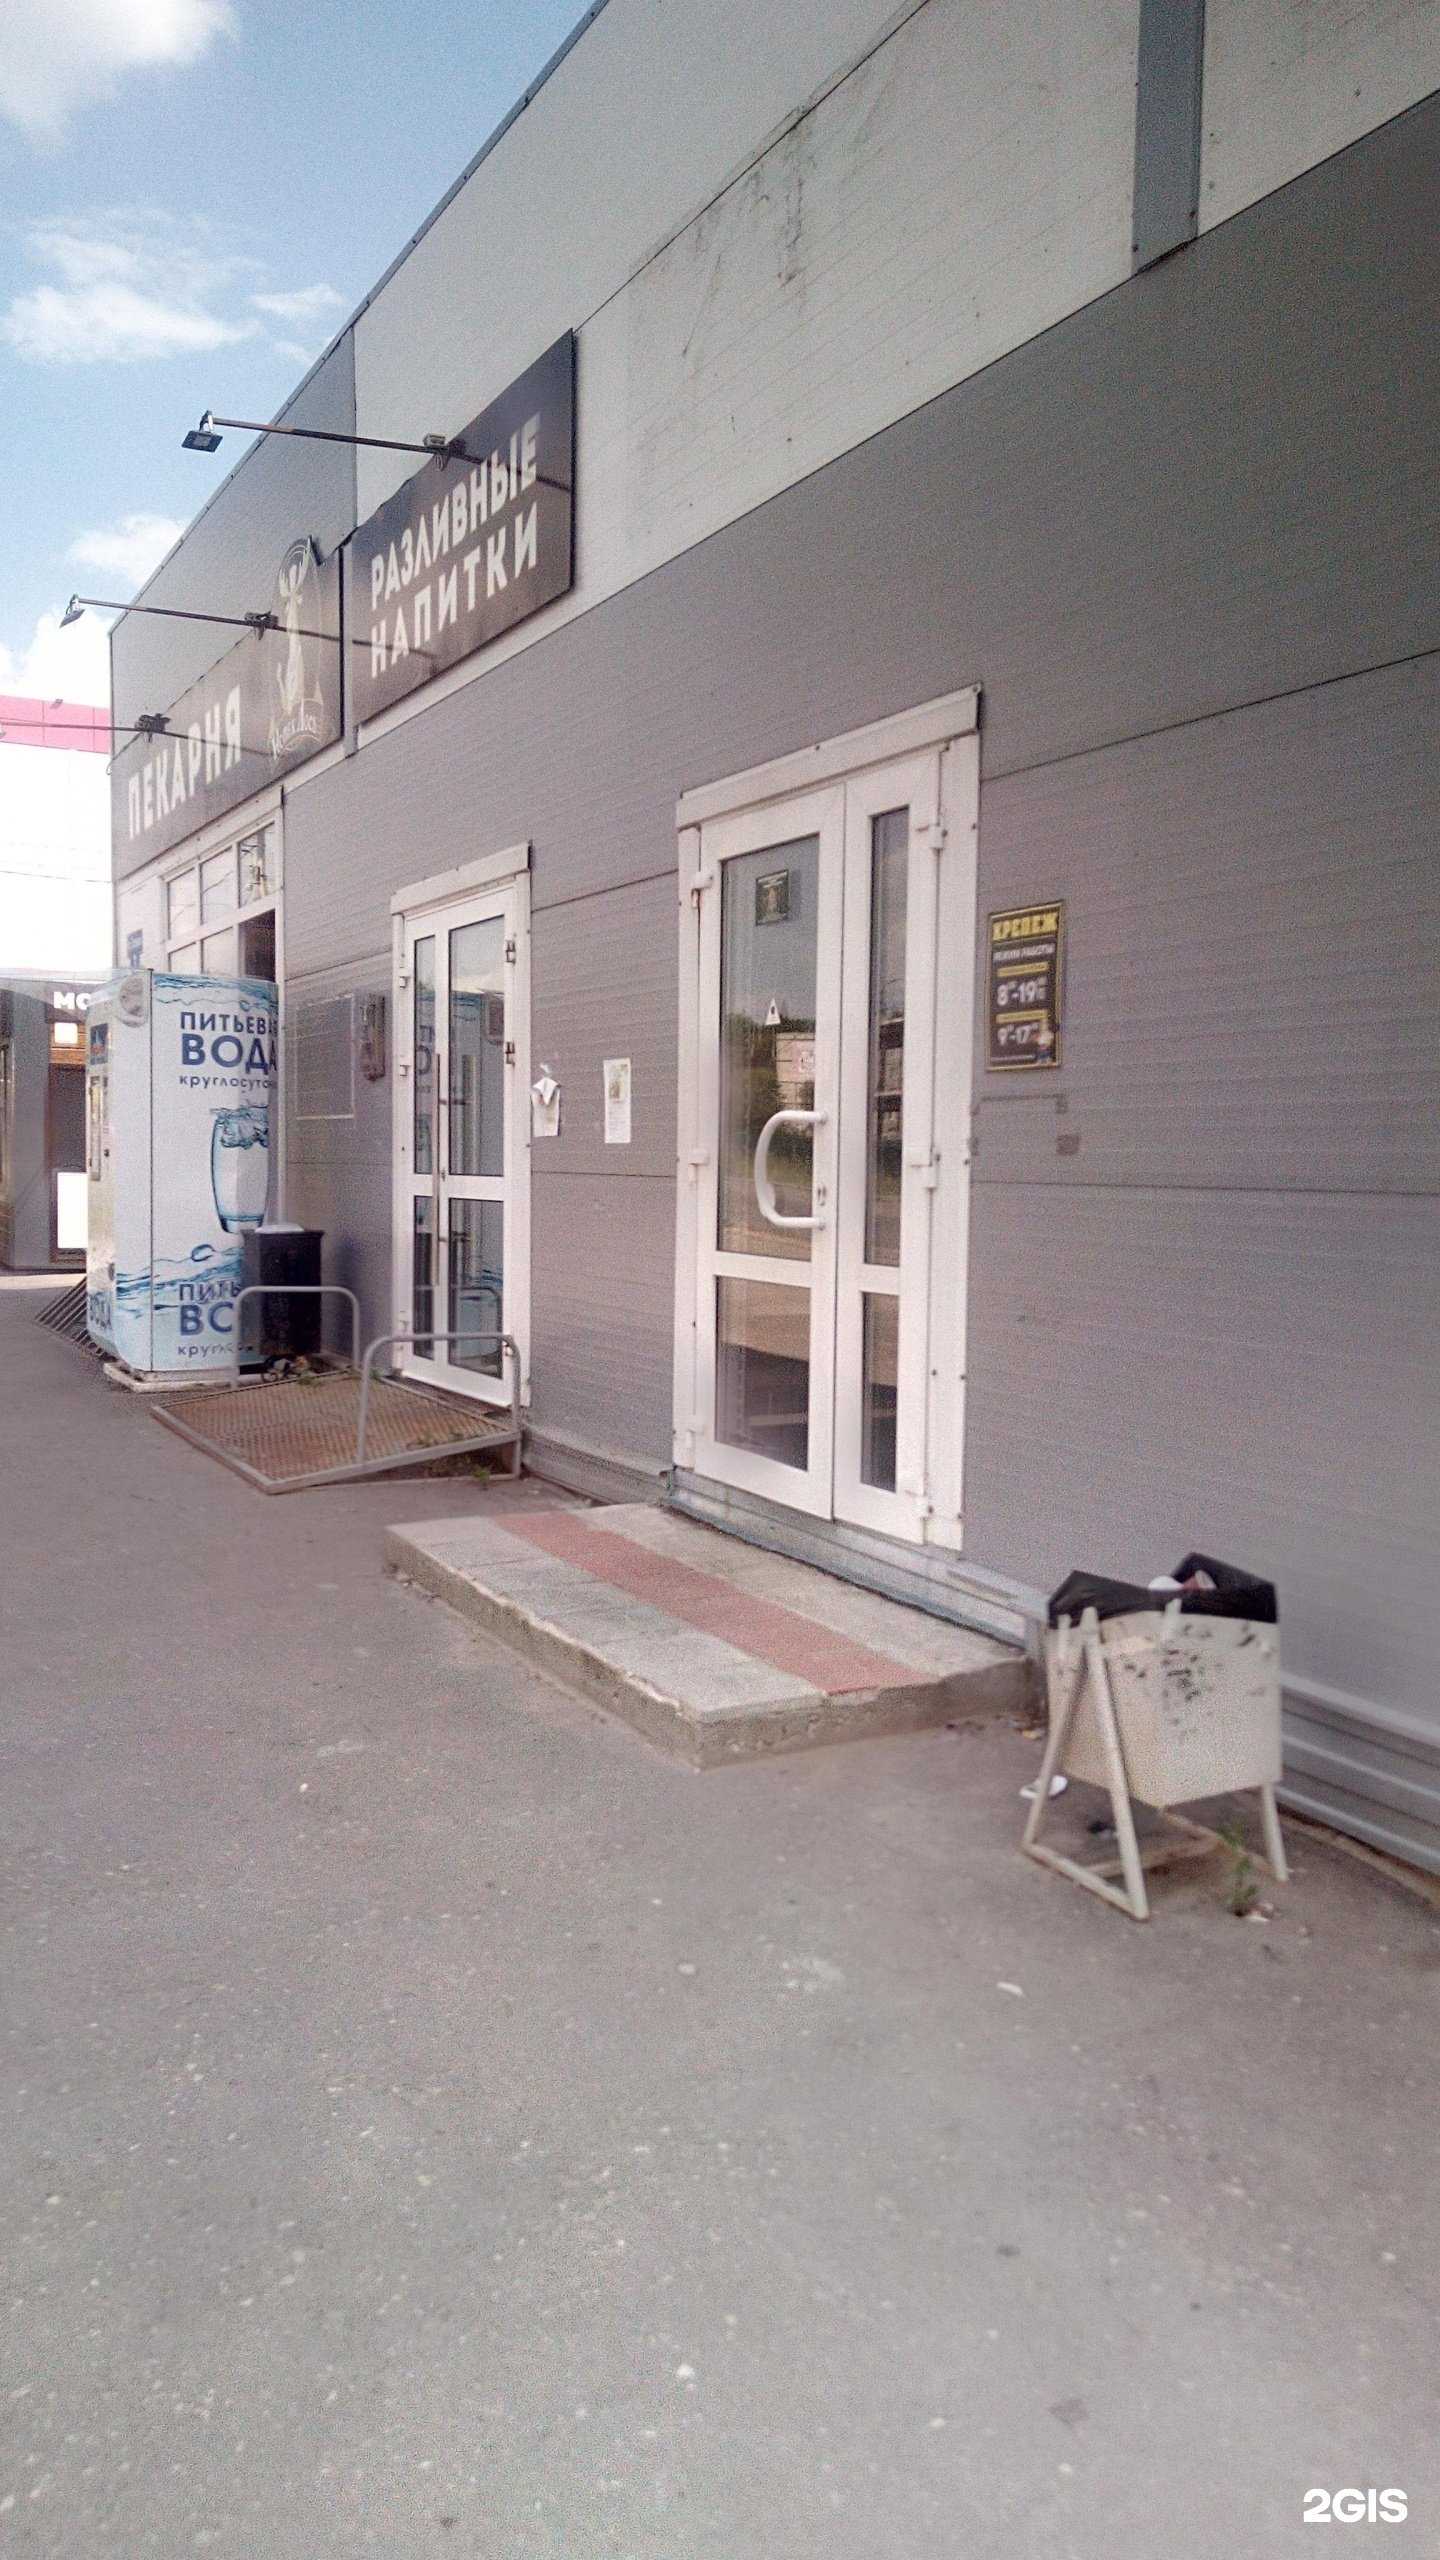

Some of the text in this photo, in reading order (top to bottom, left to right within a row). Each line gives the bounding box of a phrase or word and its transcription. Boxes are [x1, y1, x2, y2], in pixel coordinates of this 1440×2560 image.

[371, 411, 540, 611] РАЗЛИВНЫЕ
[371, 501, 537, 679] НАПИТКИ
[128, 683, 241, 840] ПЕКАРНЯ
[992, 911, 1058, 941] КРЕПЕЖ
[181, 1033, 277, 1075] ВОДА
